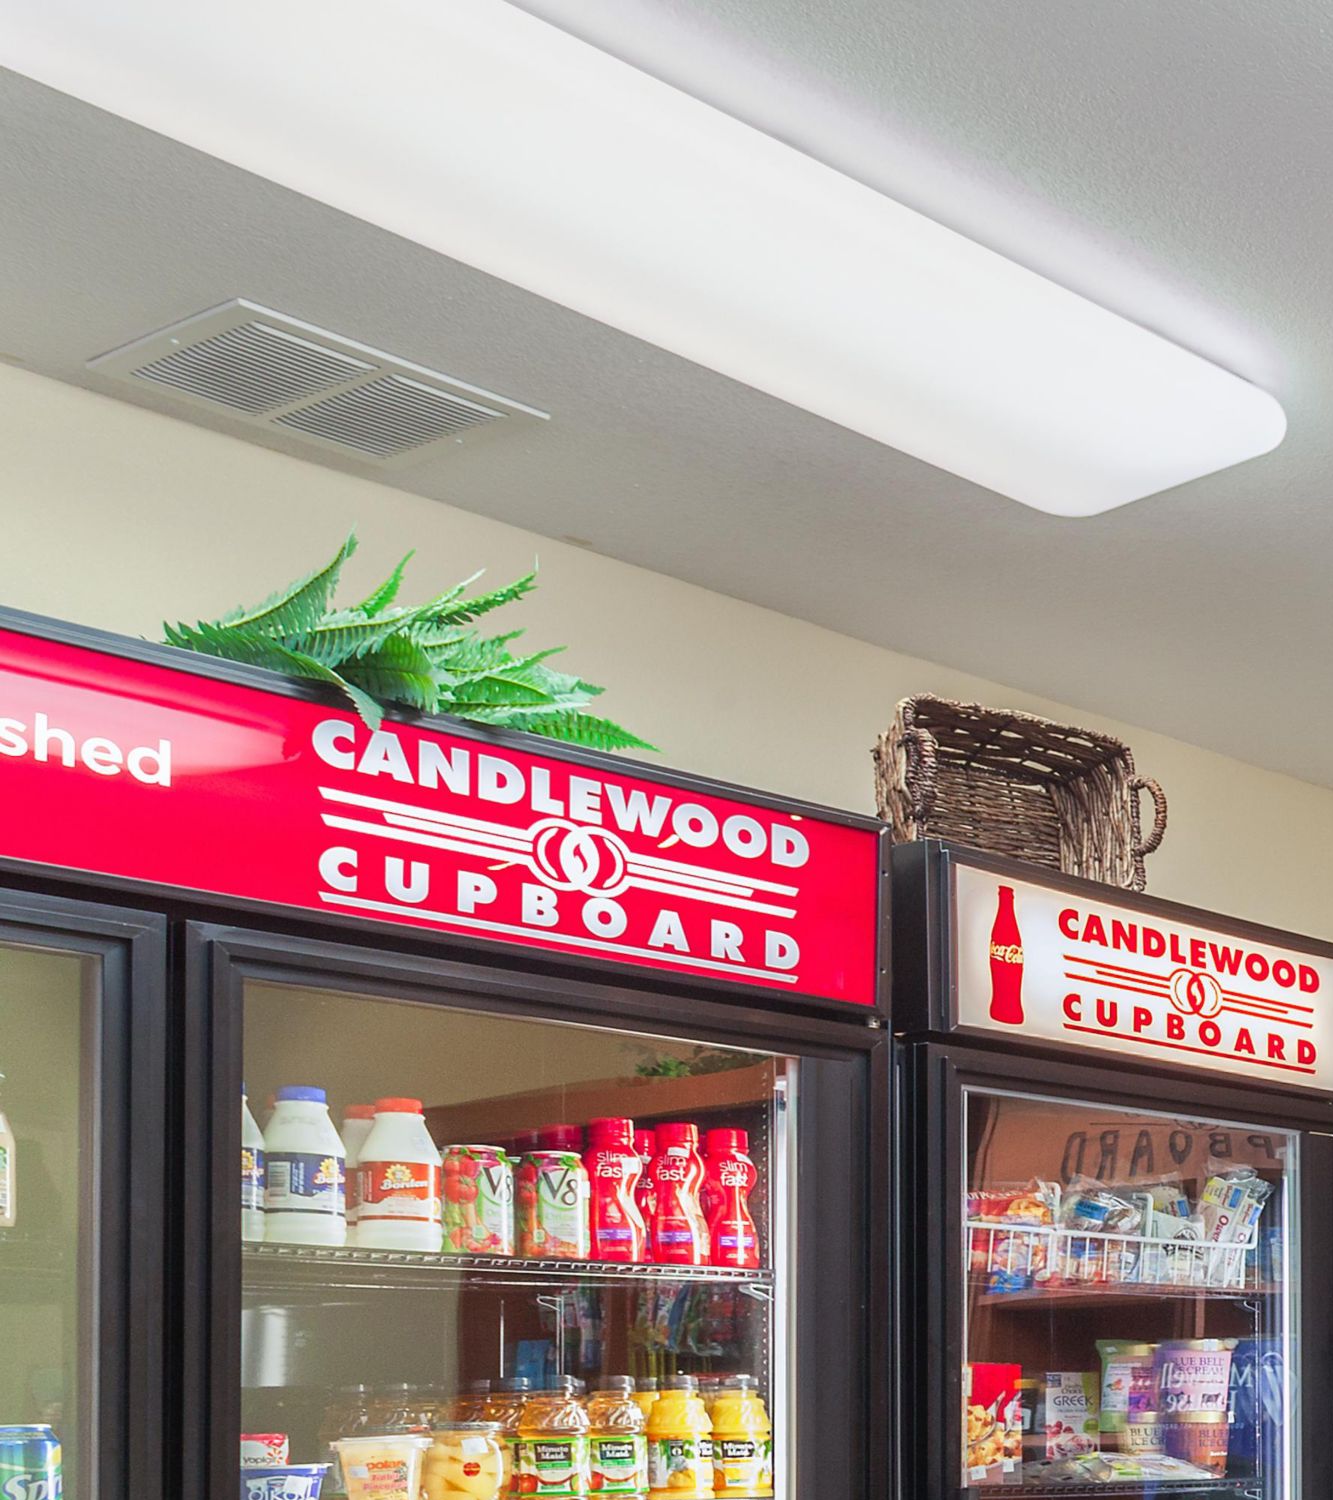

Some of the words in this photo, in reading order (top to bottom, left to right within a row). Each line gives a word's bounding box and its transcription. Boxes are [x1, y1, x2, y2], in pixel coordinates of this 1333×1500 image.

[0, 712, 172, 787] shed
[310, 718, 811, 870] CANDLEWOOD
[317, 845, 801, 972] CUPBOARD
[1058, 907, 1320, 994] CANDLEWOOD
[1062, 992, 1317, 1066] CUPBOARD
[597, 1163, 623, 1179] fas
[656, 1154, 688, 1167] slim
[656, 1166, 686, 1182] fast
[719, 1160, 748, 1173] slim
[719, 1171, 748, 1187] fast
[542, 1168, 578, 1207] V8
